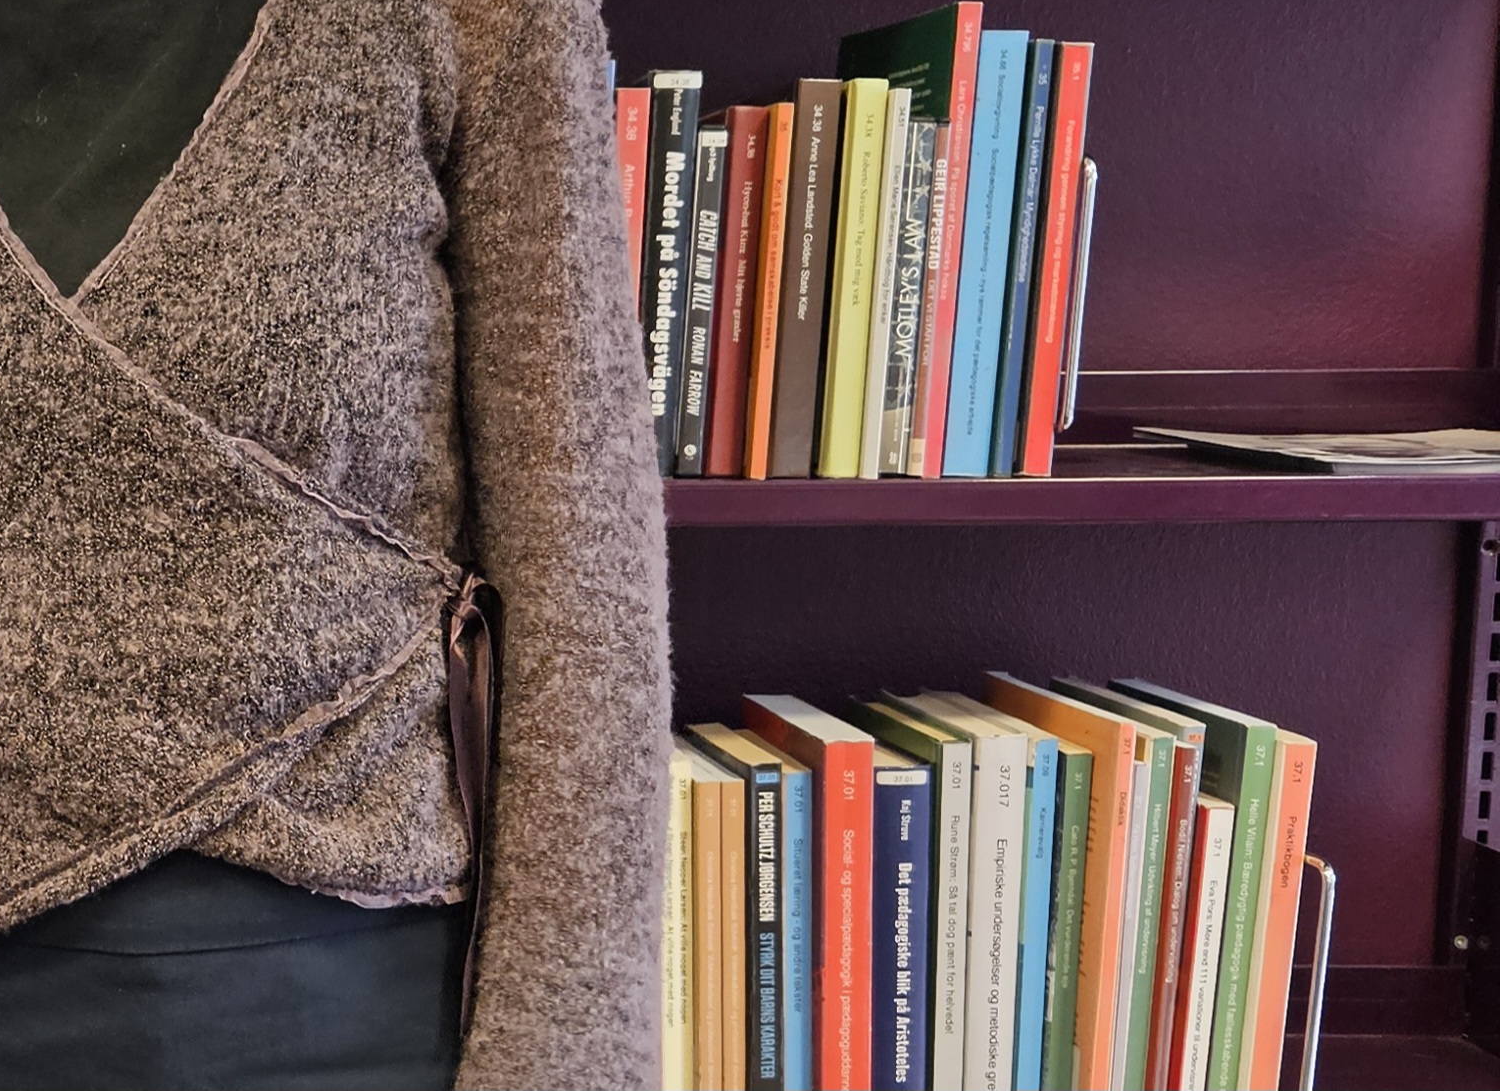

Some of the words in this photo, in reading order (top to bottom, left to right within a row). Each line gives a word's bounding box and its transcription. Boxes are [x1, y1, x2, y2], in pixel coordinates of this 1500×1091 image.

[812, 105, 824, 132] 34.38
[809, 137, 822, 161] Anne
[808, 164, 820, 183] Lea
[661, 152, 685, 230] Mordet
[696, 210, 719, 250] CATCH
[927, 195, 946, 269] LIPPESTAD
[655, 235, 680, 262] på
[801, 233, 814, 266] Golden
[694, 254, 716, 279] AND
[799, 269, 811, 294] State
[691, 282, 713, 310] KILL
[797, 296, 809, 320] Killer
[646, 268, 678, 416] Söndagsvägen
[690, 327, 707, 364] RONAN
[686, 370, 704, 416] FARROW
[951, 761, 962, 789] 37.01
[1291, 761, 1303, 783] 37.1
[759, 791, 774, 813] PER
[898, 799, 912, 813] Kaj
[759, 814, 774, 859] SCHULTZ
[950, 815, 961, 843] Rune
[1277, 816, 1298, 888] Praktikbogen
[898, 862, 912, 885] Det
[759, 861, 774, 922] JØRGENSEN
[948, 885, 959, 899] Så
[947, 902, 958, 915] tal
[893, 888, 912, 968] pædagogiske
[944, 918, 958, 938] dog
[760, 933, 775, 967] STYRK
[943, 941, 957, 969] pænt
[760, 969, 775, 985] DIT
[896, 971, 911, 996] blik
[945, 971, 956, 986] for
[760, 988, 775, 1023] BARNS
[892, 998, 910, 1013] på
[760, 1025, 775, 1078] KARAKTER
[895, 1016, 910, 1083] Aristoteles
